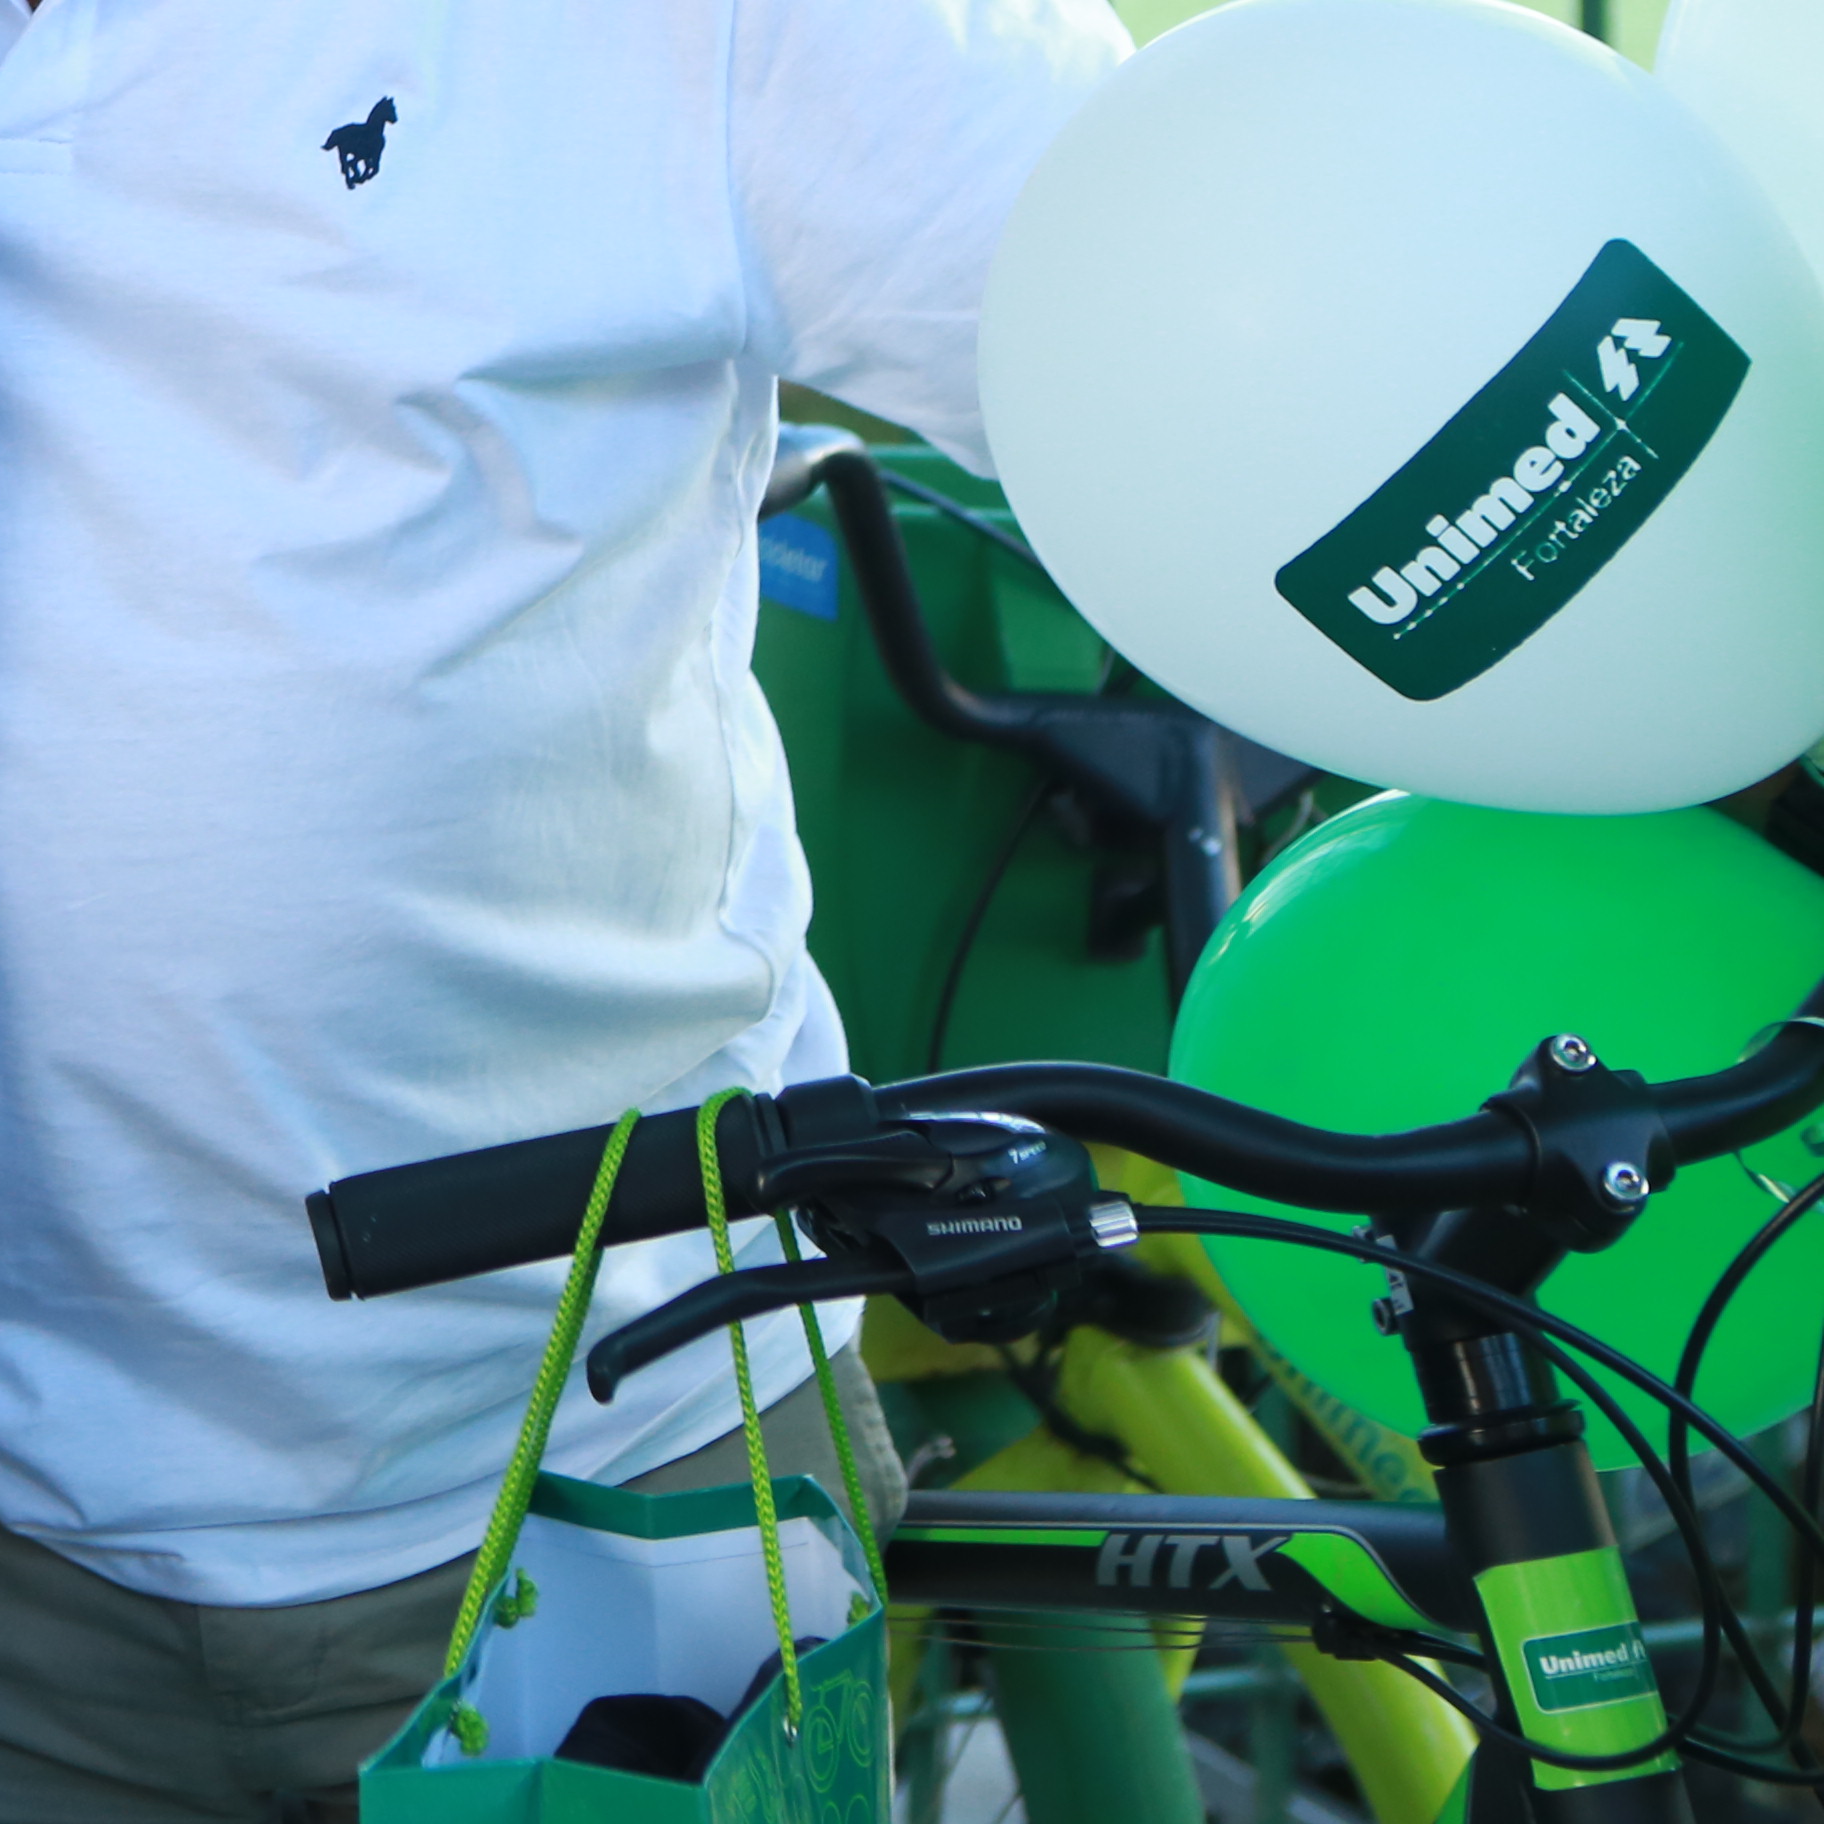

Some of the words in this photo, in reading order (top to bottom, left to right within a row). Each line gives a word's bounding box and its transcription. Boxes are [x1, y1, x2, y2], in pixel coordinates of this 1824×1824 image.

[1348, 392, 1601, 624] Unimed
[1512, 454, 1642, 581] Fortaleza
[927, 1215, 1022, 1235] SHIMANO
[1096, 1533, 1292, 1592] HTX
[1539, 1642, 1629, 1675] Unimed
